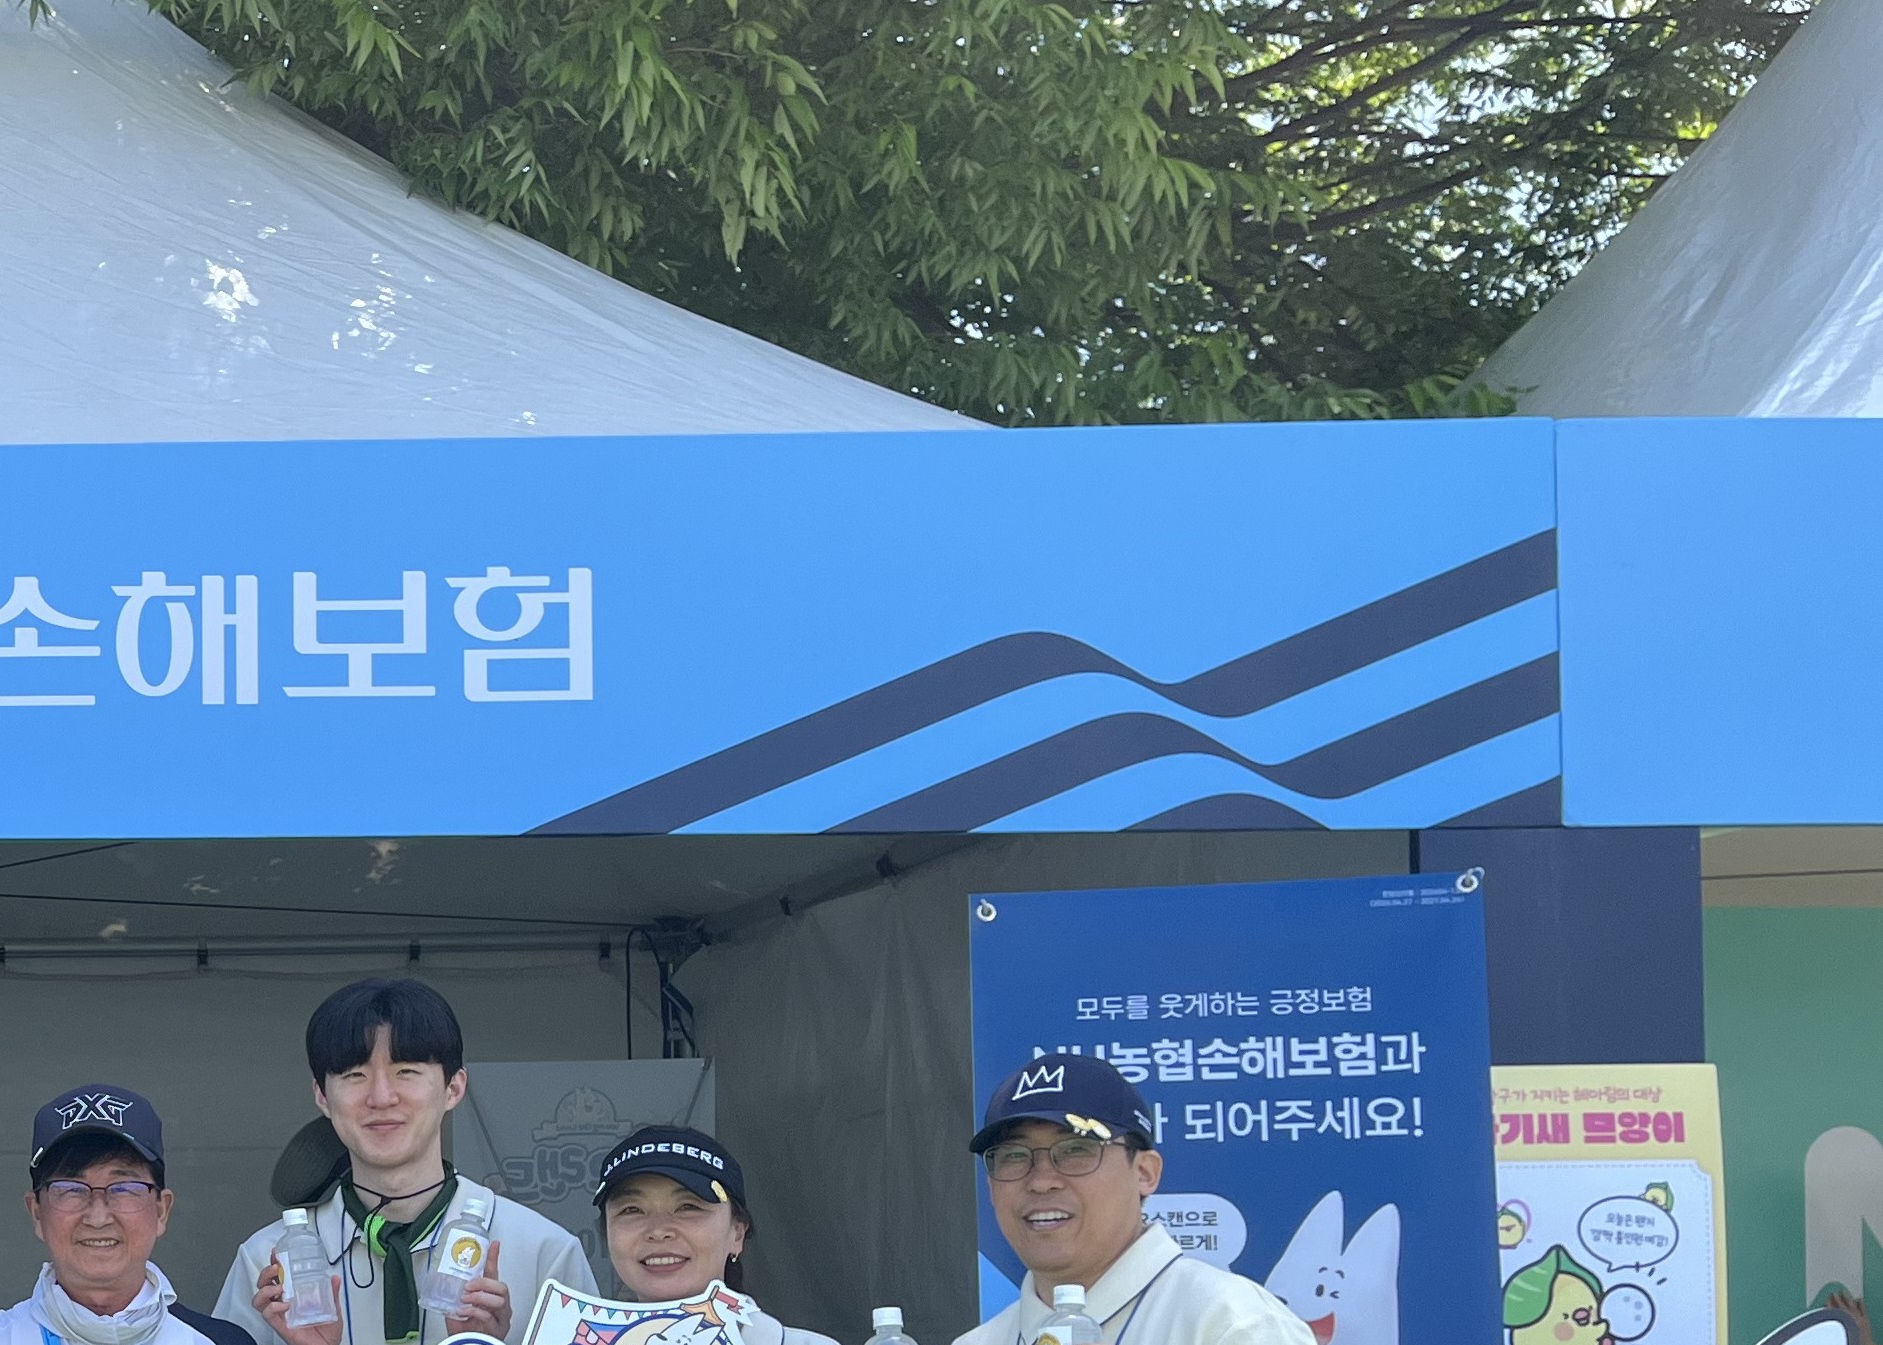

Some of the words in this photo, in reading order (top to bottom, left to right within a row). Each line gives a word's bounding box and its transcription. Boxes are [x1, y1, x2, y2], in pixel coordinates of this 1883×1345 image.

[1076, 995, 1150, 1022] 모두를
[1159, 991, 1260, 1020] 웃게하는
[1269, 986, 1373, 1017] 긍정보험
[1493, 1087, 1527, 1102] 구가
[1184, 1097, 1425, 1143] 되어주세요!
[1493, 1112, 1571, 1145] 기새
